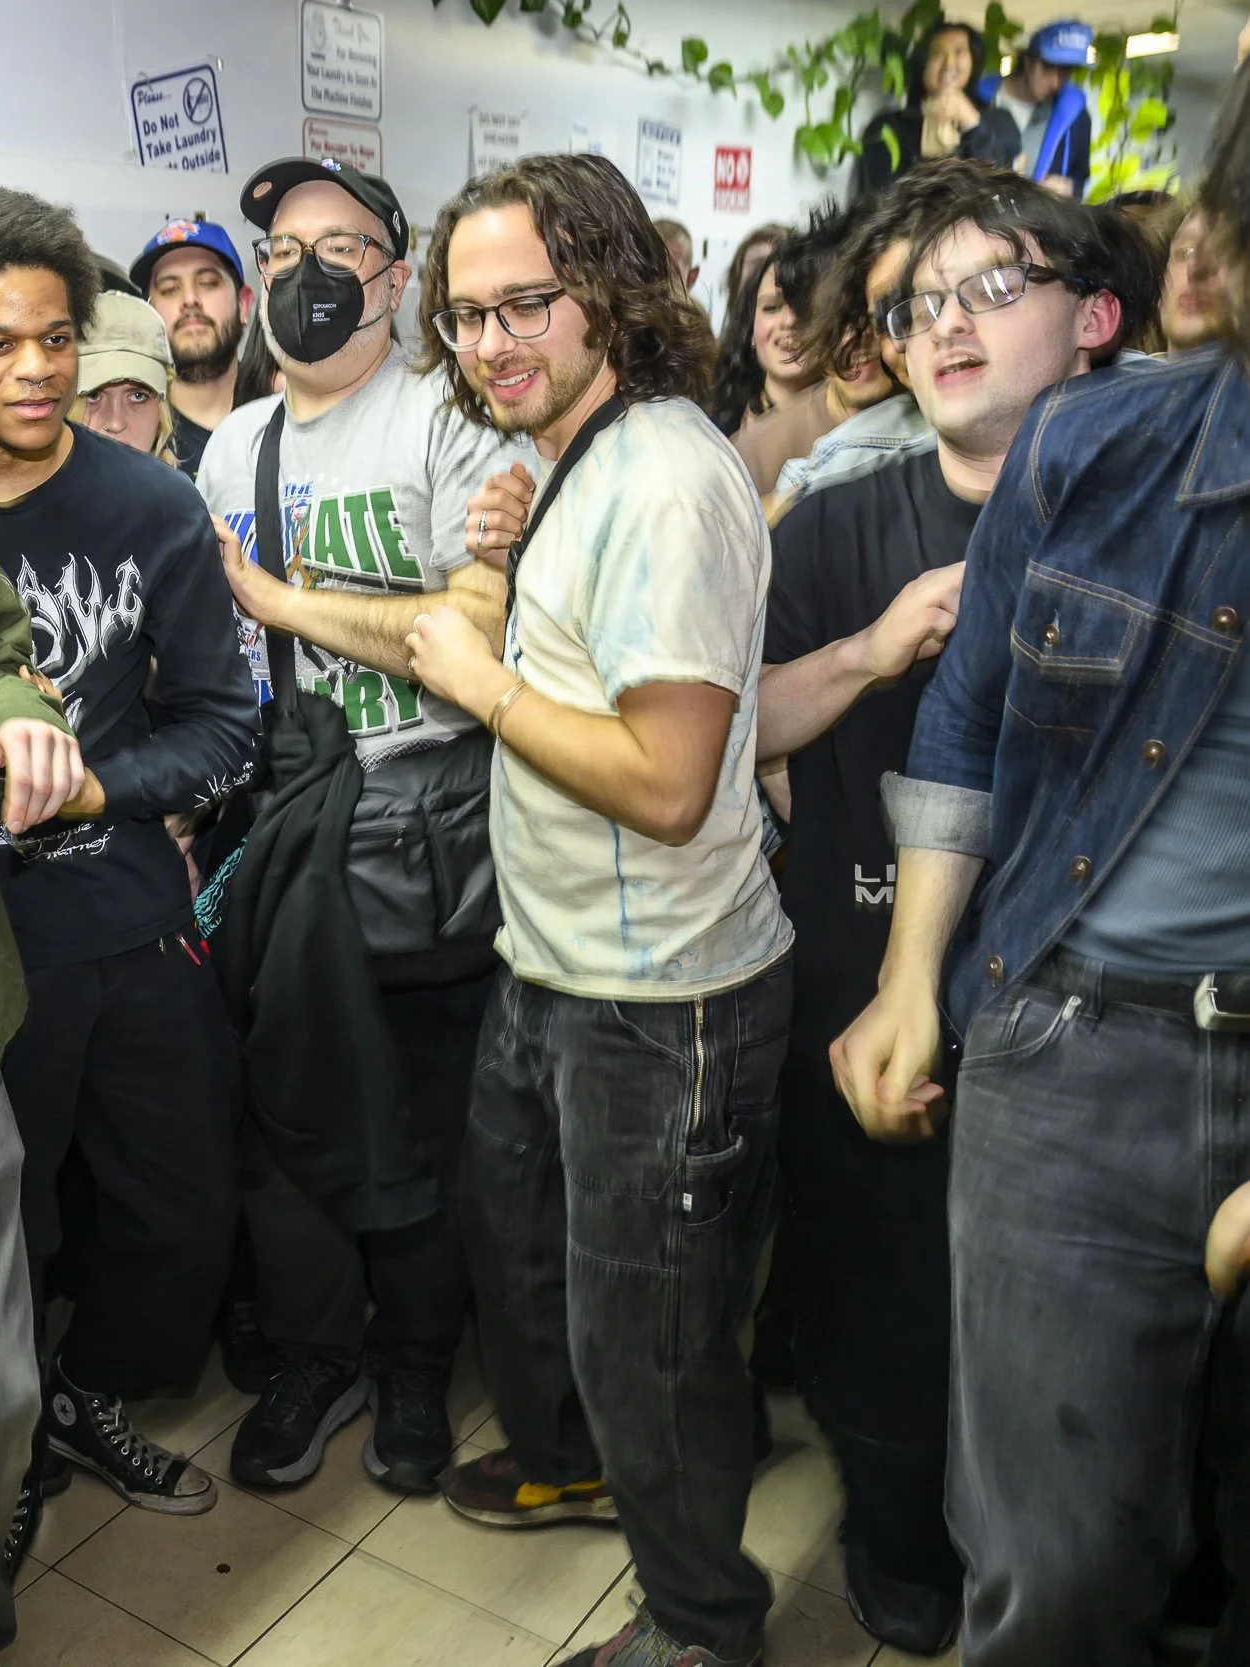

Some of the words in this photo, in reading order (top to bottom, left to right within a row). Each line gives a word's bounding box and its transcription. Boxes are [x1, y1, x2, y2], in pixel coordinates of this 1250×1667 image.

[143, 120, 157, 136] Do
[160, 112, 179, 132] Not
[146, 140, 172, 159] Take
[175, 127, 216, 150] Laundry
[182, 148, 221, 171] Outside
